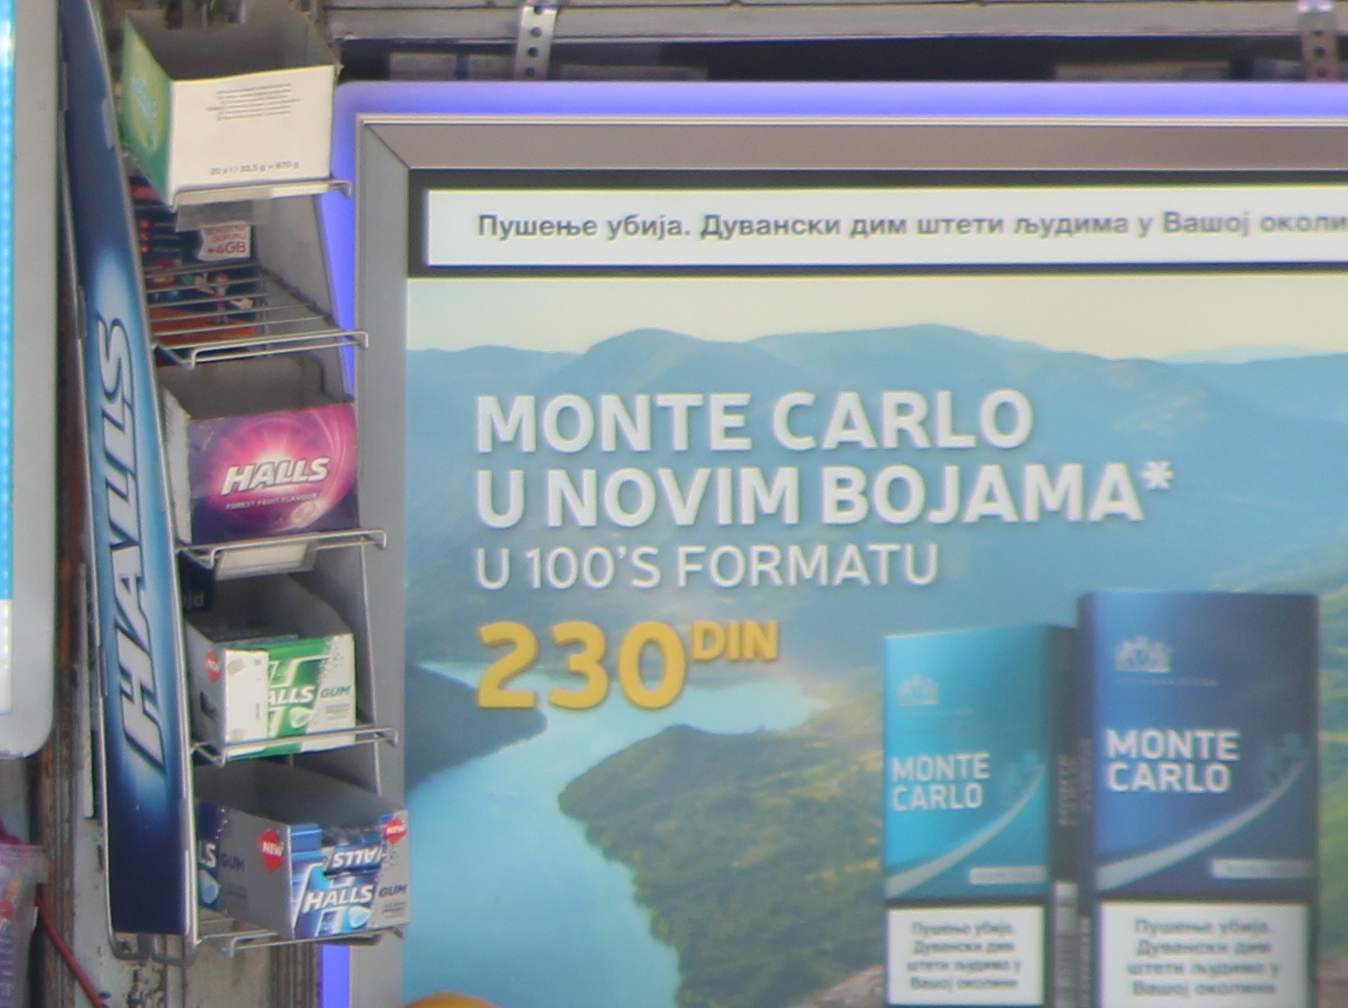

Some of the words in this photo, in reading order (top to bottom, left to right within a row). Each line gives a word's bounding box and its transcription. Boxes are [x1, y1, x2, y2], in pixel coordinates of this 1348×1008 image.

[477, 214, 598, 241] Пушење
[607, 211, 692, 243] убија.
[702, 214, 841, 243] Дувански
[850, 215, 908, 240] дим
[917, 214, 1005, 237] штети
[1013, 212, 1130, 240] људима
[1137, 216, 1154, 240] у
[1162, 210, 1250, 238] Вашој
[476, 392, 753, 455] MONTE
[771, 386, 1035, 452] CARLO
[222, 457, 331, 495] HALLS
[476, 467, 526, 529] U
[547, 465, 802, 528] NOVIM
[98, 317, 168, 776] HALLS
[476, 547, 512, 590] U
[677, 543, 940, 588] FORMATU
[476, 620, 688, 712] 230
[691, 621, 779, 663] DIN
[1105, 728, 1240, 761] MONTE
[1106, 760, 1231, 794] CARLO
[303, 884, 374, 914] HALLS
[379, 884, 408, 898] GUM
